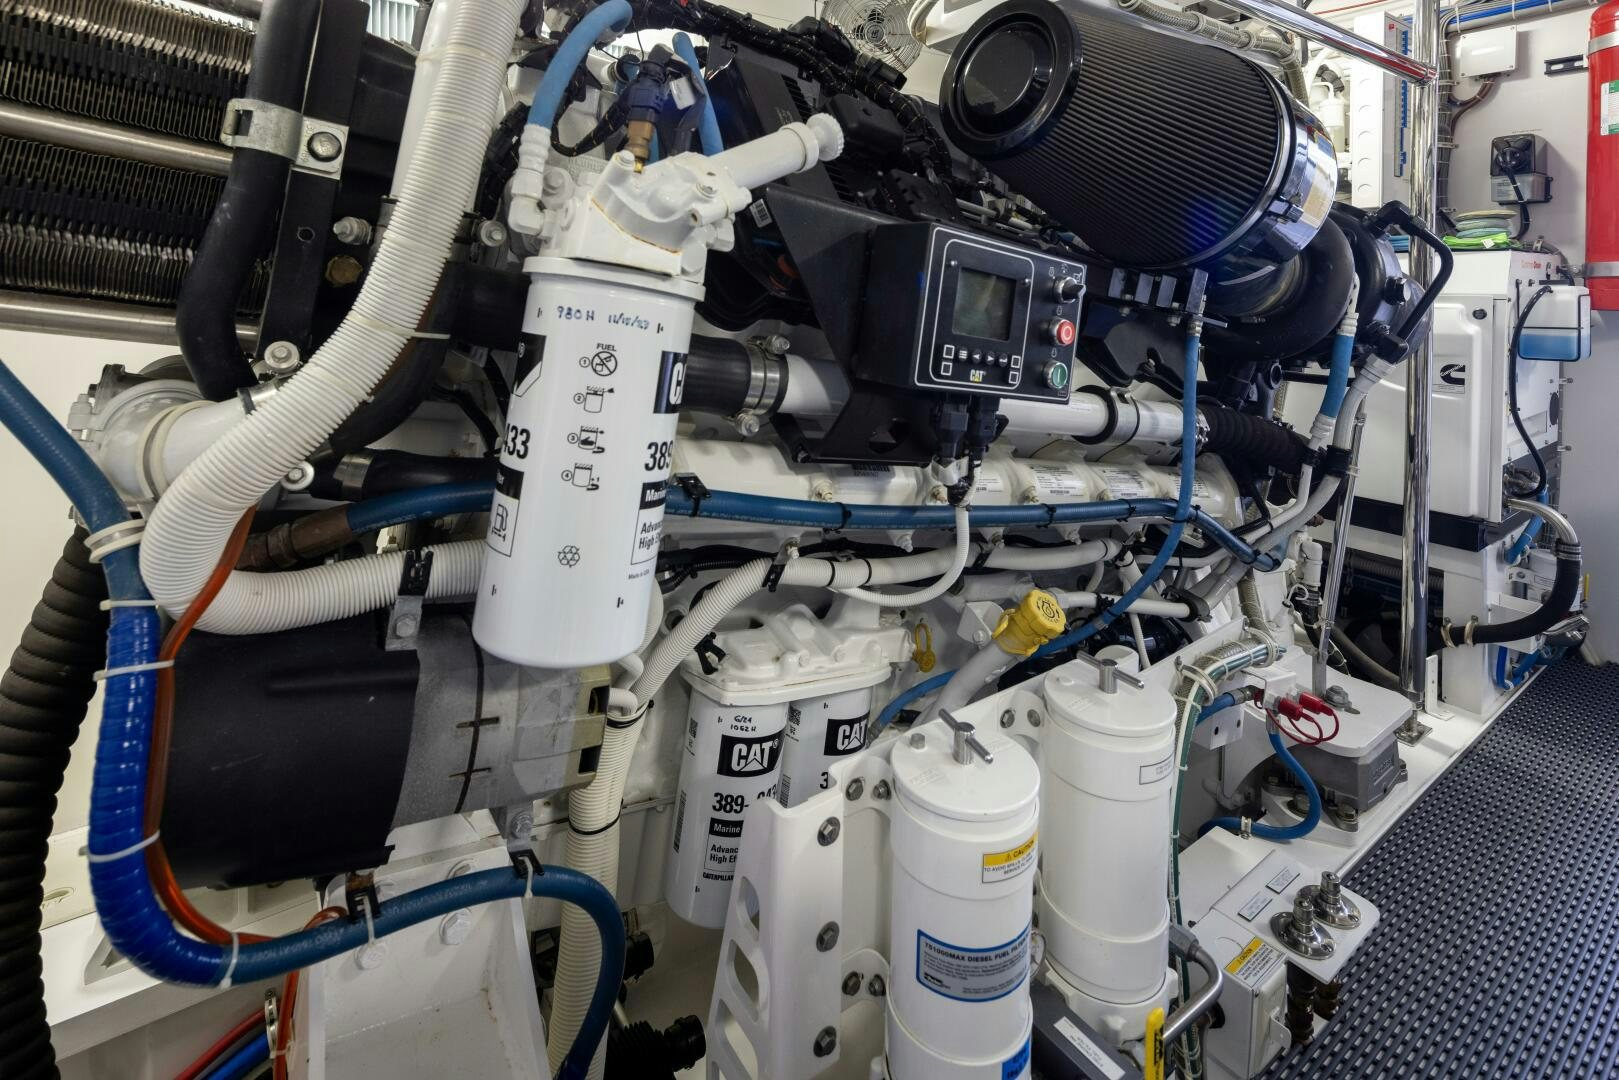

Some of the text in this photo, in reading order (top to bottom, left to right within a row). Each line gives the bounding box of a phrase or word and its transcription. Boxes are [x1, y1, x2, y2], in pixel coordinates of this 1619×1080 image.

[595, 343, 617, 352] FUEL
[970, 369, 985, 382] CAT
[731, 740, 774, 773] CAT
[713, 822, 741, 834] Marine
[710, 843, 738, 853] Advanc
[709, 853, 727, 864] High
[967, 954, 993, 963] DIESEL
[994, 951, 1010, 960] FUEL
